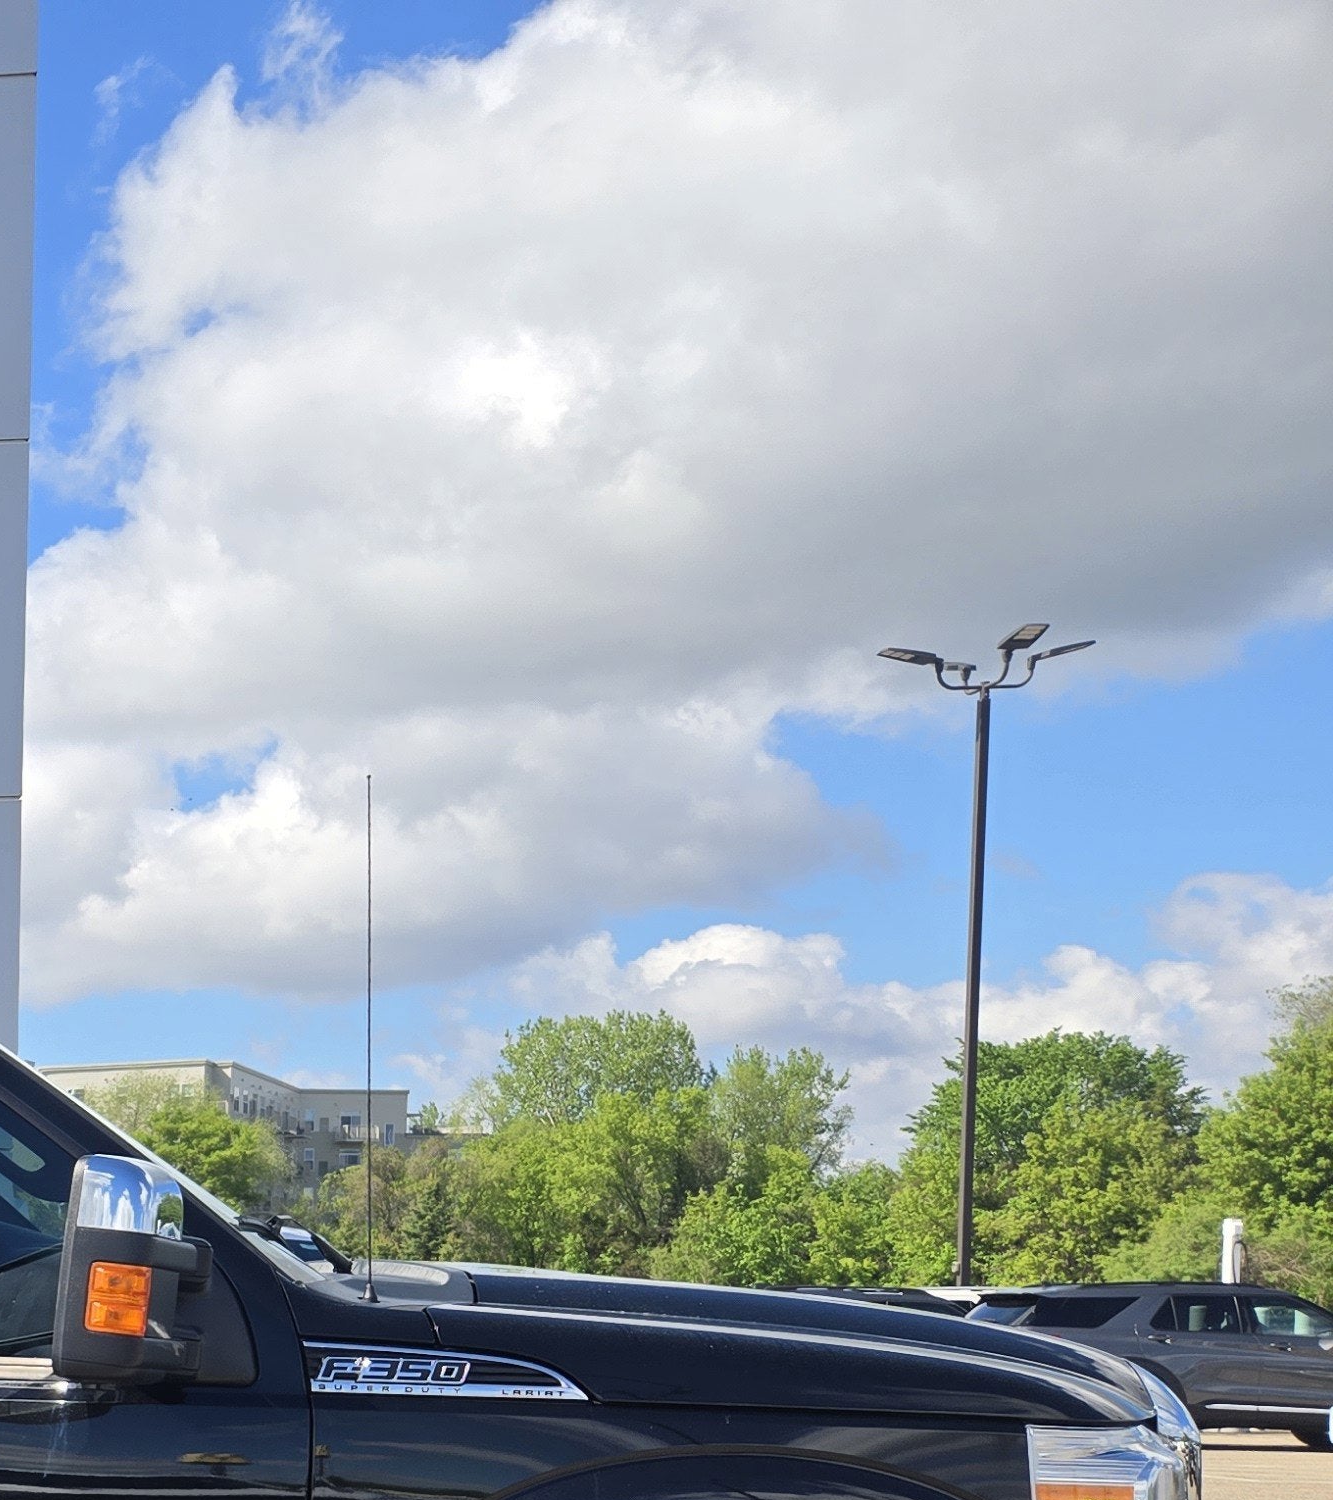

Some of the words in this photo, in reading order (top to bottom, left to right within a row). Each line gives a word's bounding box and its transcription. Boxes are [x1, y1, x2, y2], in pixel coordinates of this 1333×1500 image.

[317, 1383, 390, 1393] SUPER
[404, 1386, 462, 1394] DUTY
[501, 1388, 566, 1397] LARIAT
